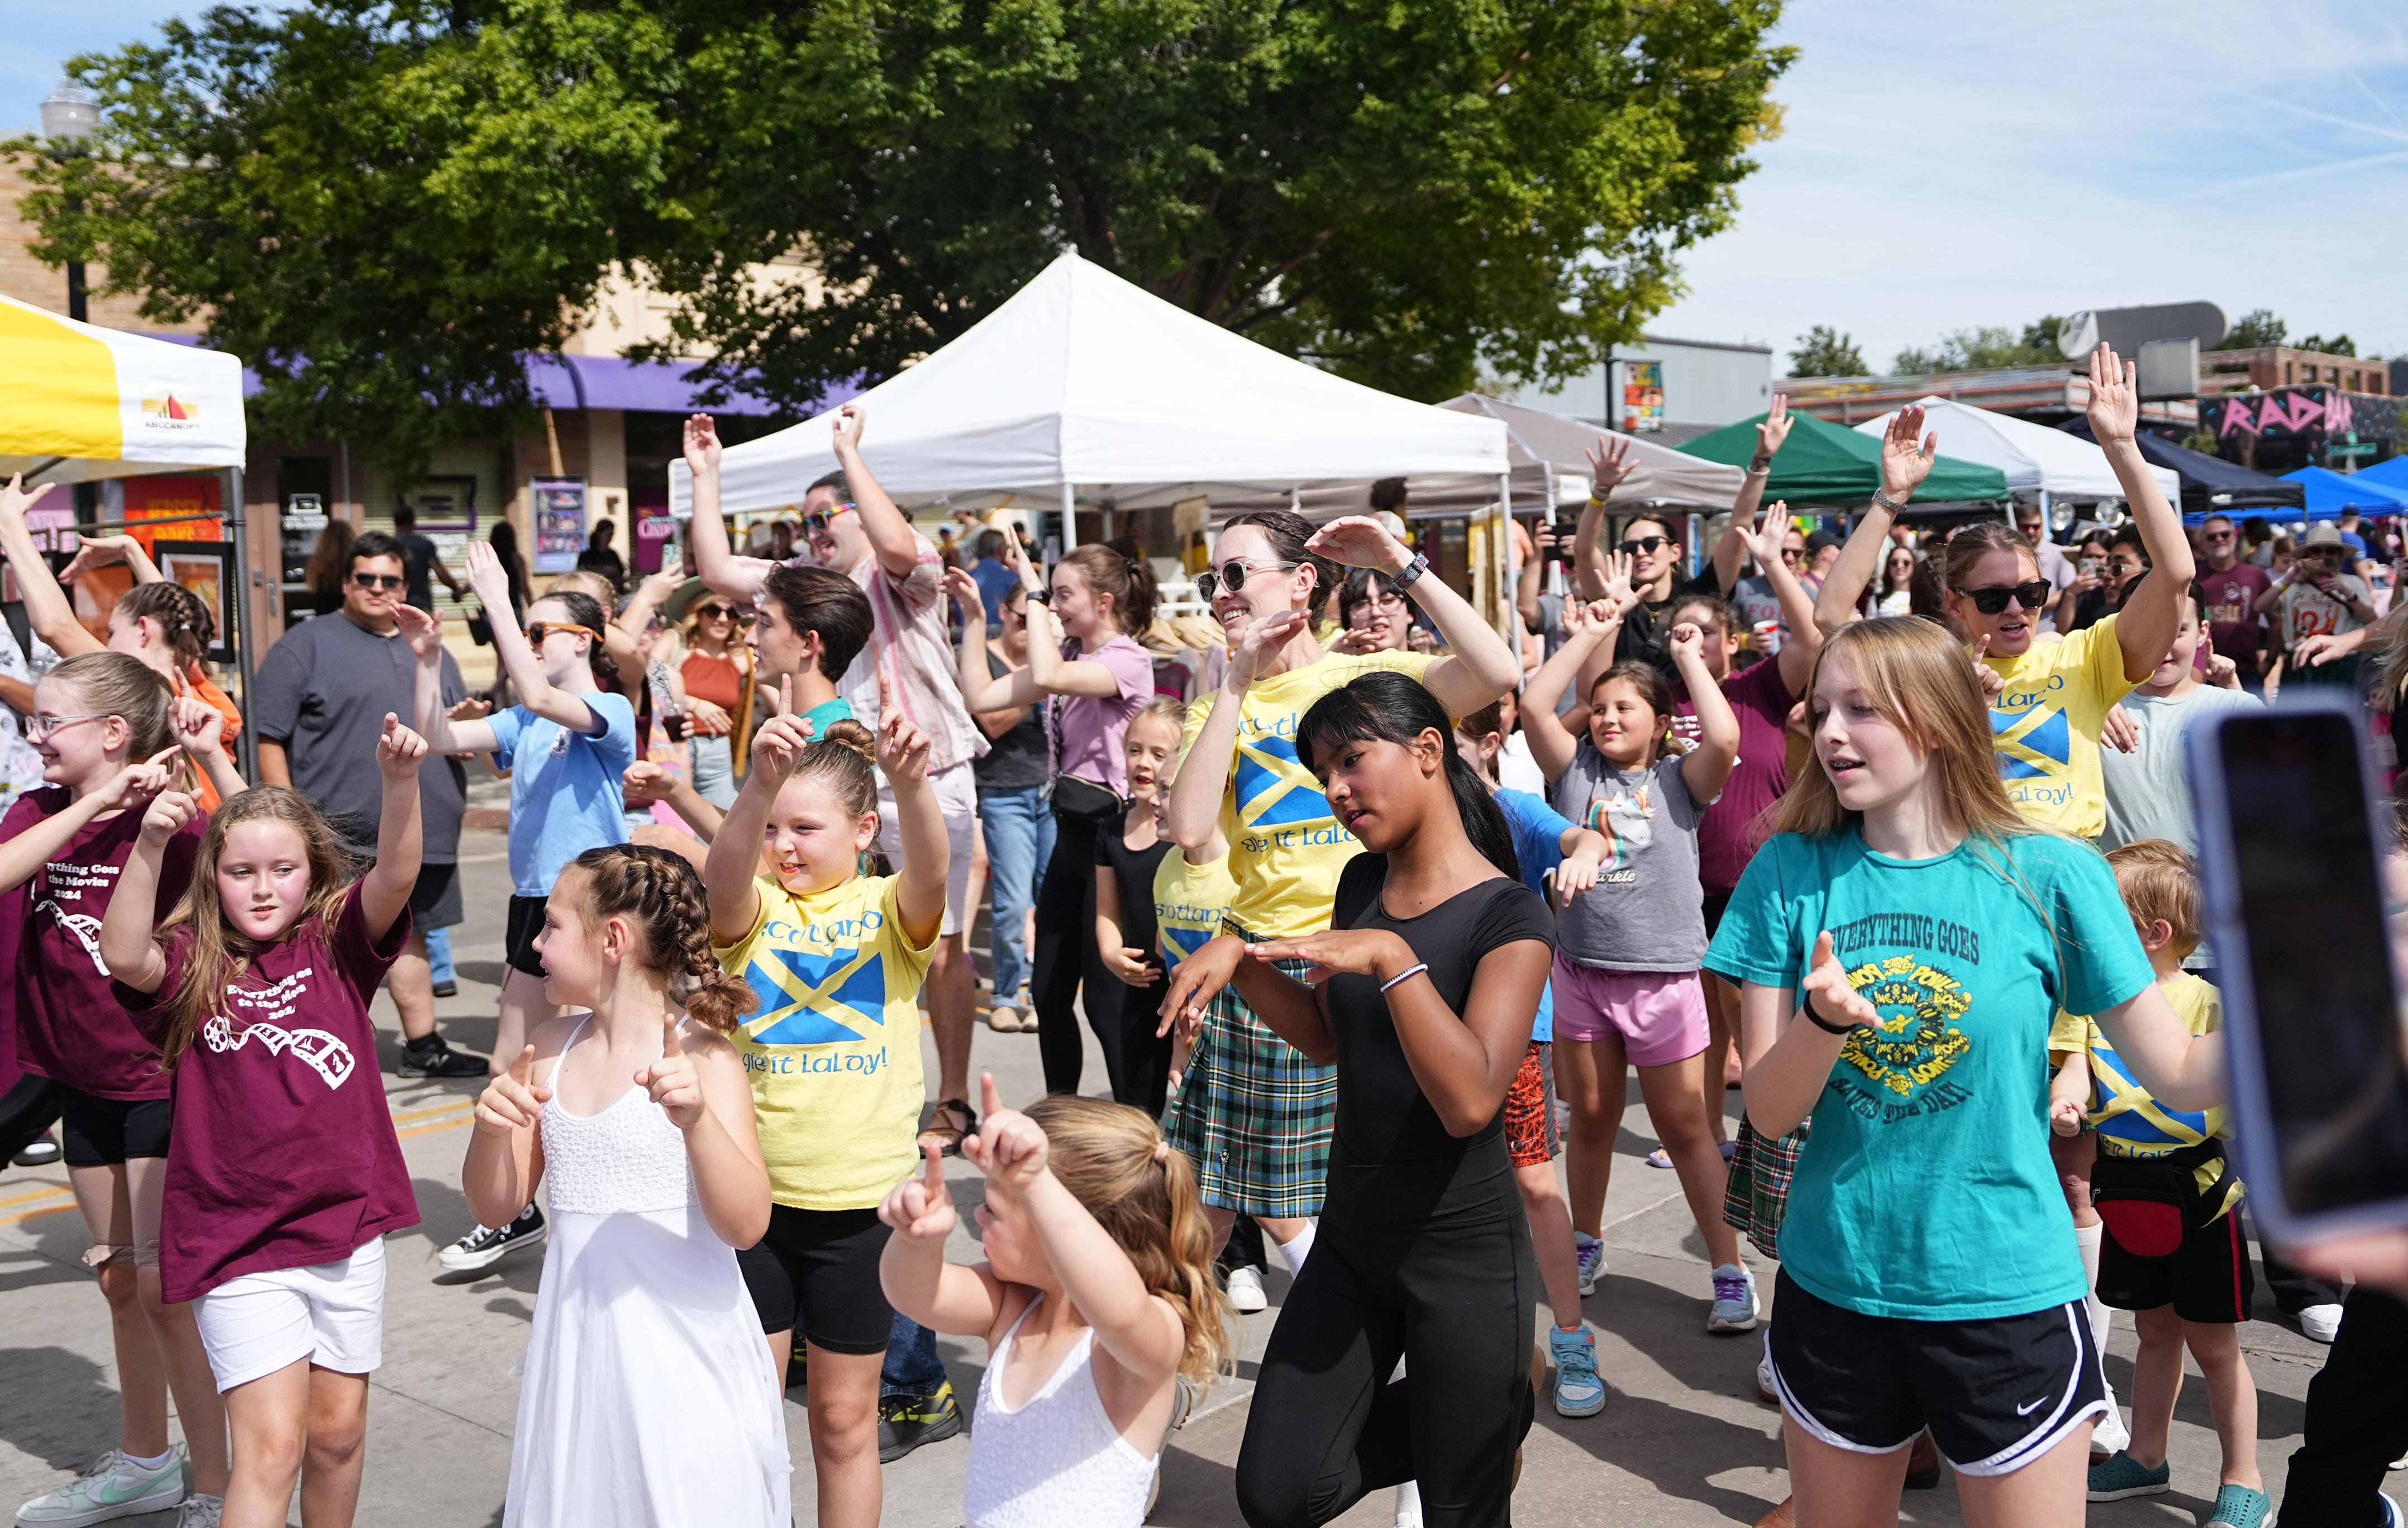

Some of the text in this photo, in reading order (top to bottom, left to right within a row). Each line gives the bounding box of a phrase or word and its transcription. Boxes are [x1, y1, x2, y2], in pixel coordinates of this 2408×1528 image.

[2219, 391, 2325, 440] RAD
[45, 862, 89, 876] rything
[1596, 869, 1636, 884] arkle
[48, 875, 109, 887] the Movies
[54, 889, 82, 900] 2024
[1938, 918, 1980, 966] GOES
[1906, 964, 1962, 994] POW!
[237, 998, 254, 1007] to
[255, 1000, 280, 1009] the
[268, 1004, 296, 1020] 202
[1828, 1077, 1974, 1124] SAVES THE DAY!
